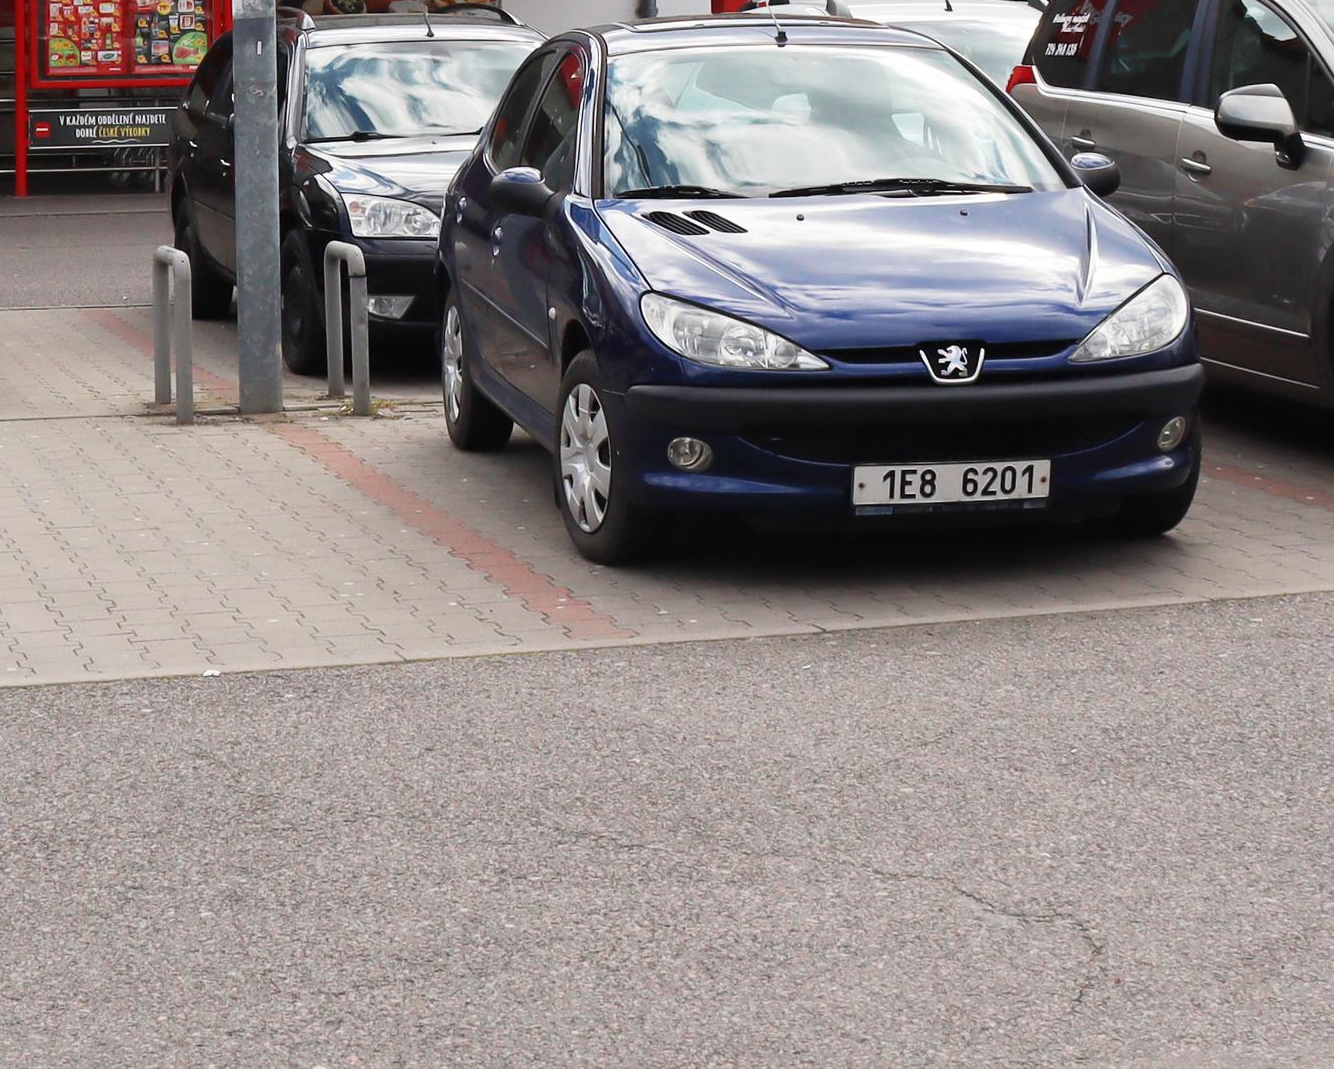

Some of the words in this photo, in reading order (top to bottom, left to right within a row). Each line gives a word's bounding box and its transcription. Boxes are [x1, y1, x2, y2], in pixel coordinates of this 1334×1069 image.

[59, 114, 65, 126] V
[66, 113, 96, 125] KAŽDÉM
[97, 112, 134, 125] ODDĚLENÍ
[135, 113, 166, 124] NAJDETE
[882, 468, 937, 500] 1E8
[961, 464, 1035, 498] 6201
